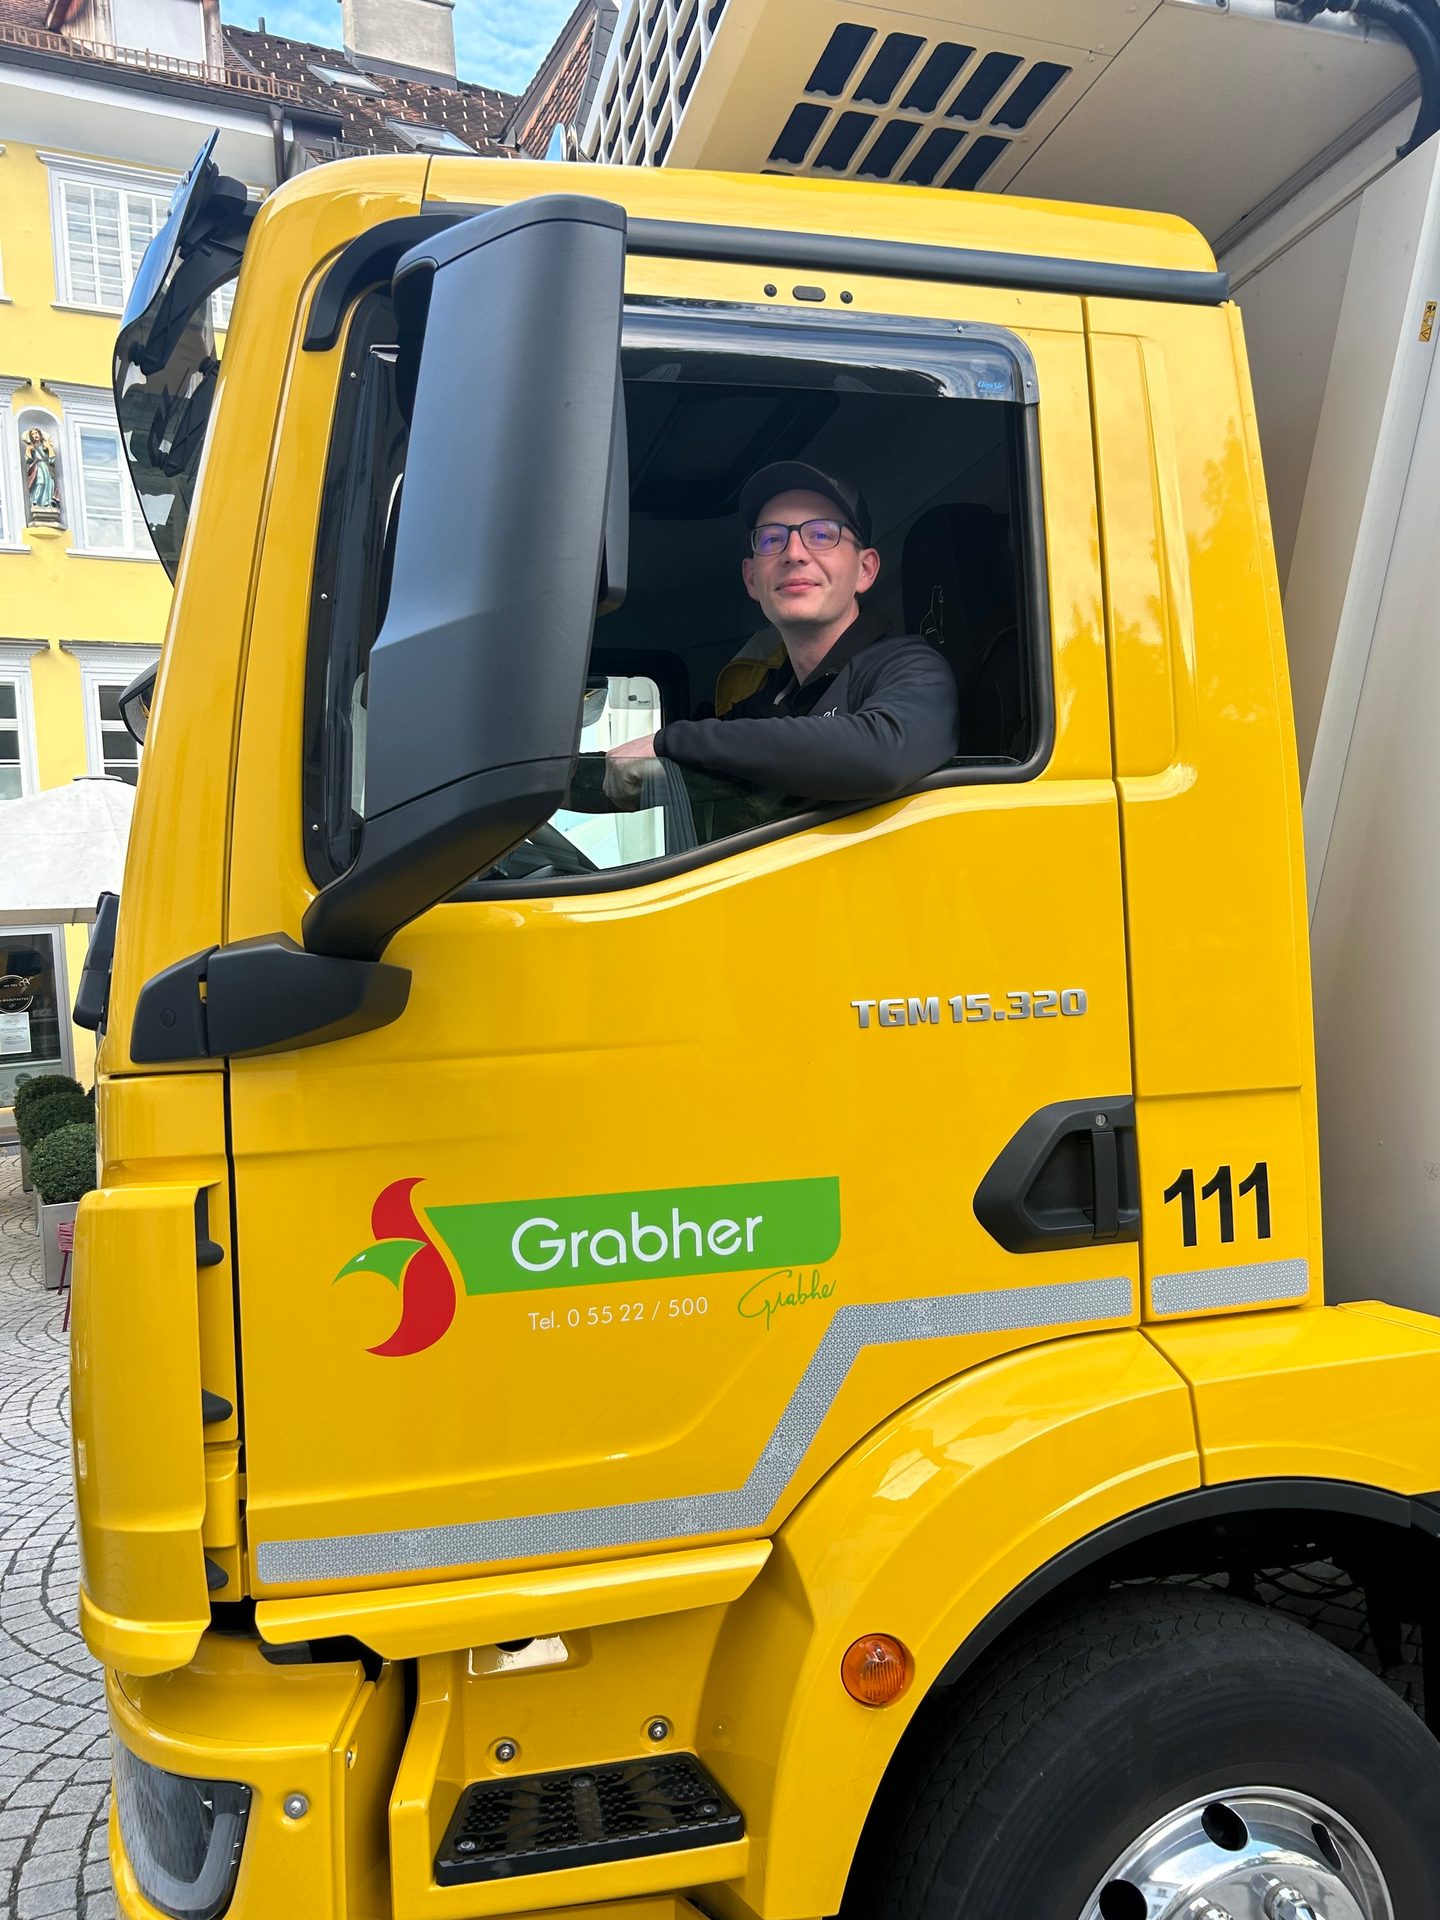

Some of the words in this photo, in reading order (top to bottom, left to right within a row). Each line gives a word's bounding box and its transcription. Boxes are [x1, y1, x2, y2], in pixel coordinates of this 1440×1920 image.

[850, 996, 940, 1029] TGM
[948, 988, 1088, 1023] 15.320
[1163, 1161, 1271, 1248] 111
[511, 1207, 763, 1272] Grabher
[528, 1311, 561, 1330] Tel.
[567, 1308, 580, 1327] 0
[587, 1306, 613, 1325] 55
[619, 1302, 645, 1322] 22
[668, 1296, 709, 1318] 500
